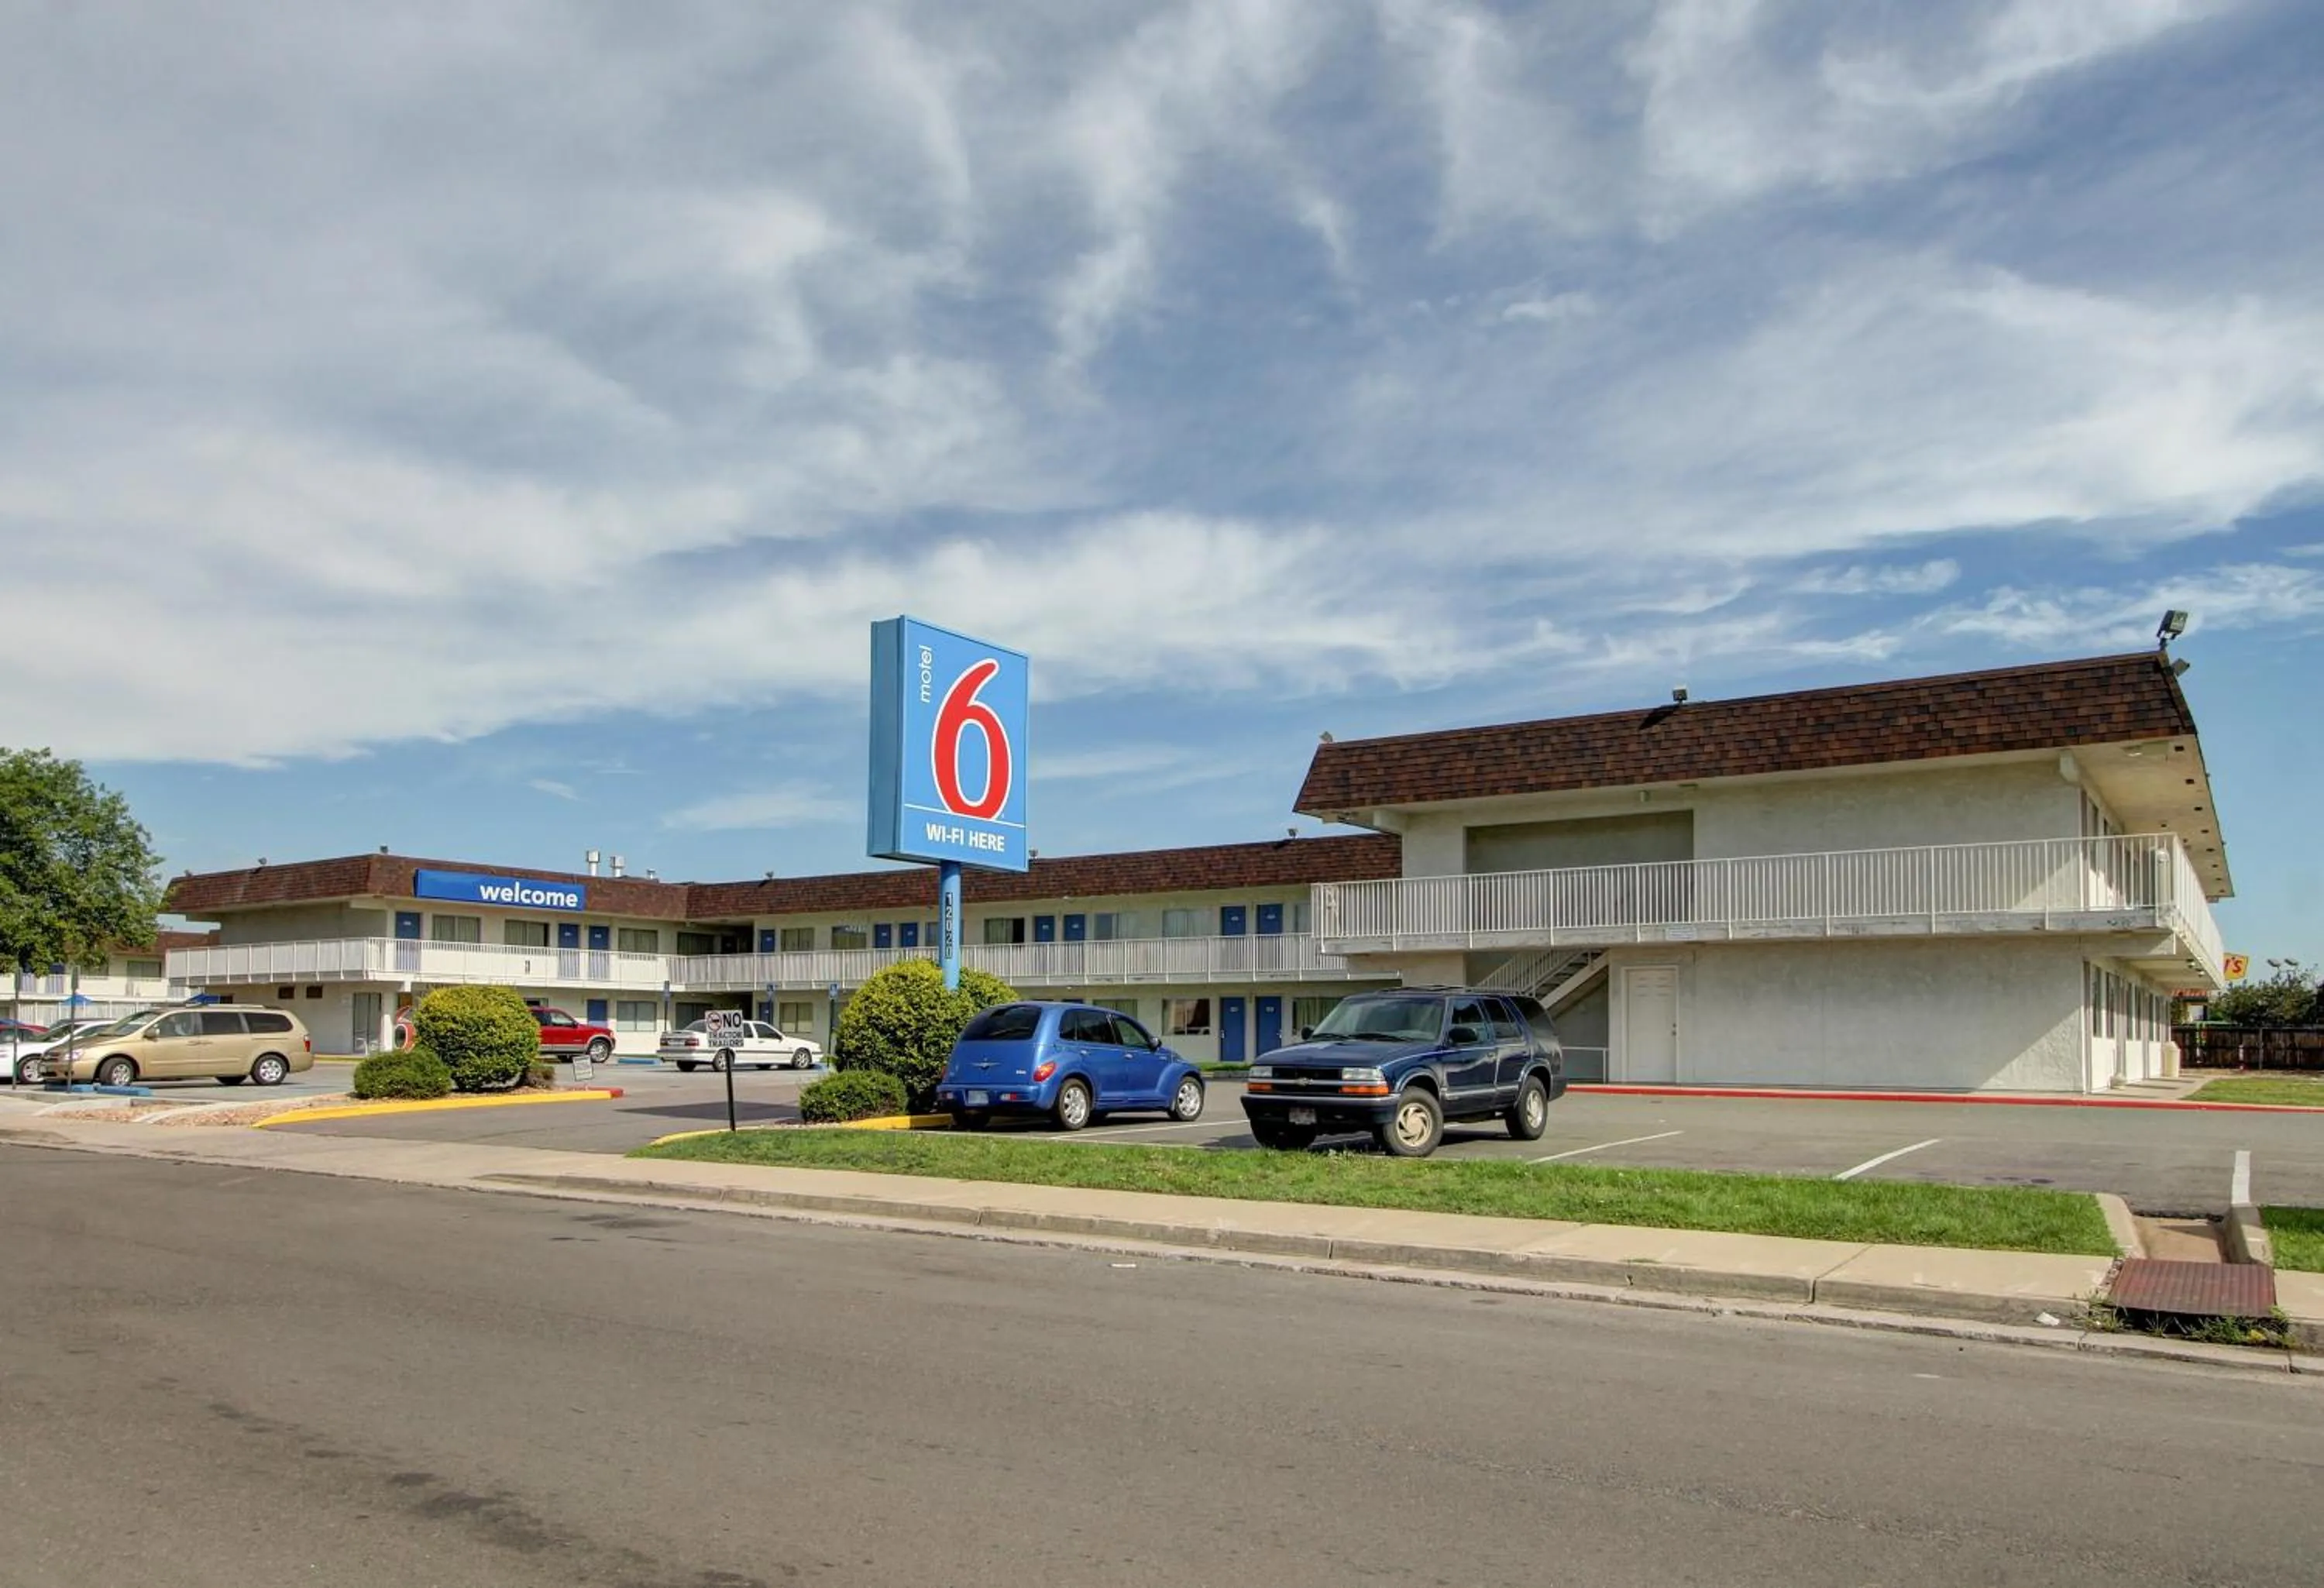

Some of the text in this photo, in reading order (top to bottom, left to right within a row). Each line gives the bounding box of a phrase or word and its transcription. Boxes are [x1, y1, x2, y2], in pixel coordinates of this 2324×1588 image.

[919, 644, 932, 703] motel
[931, 658, 1012, 821] 6
[927, 822, 1005, 852] WI-FI HERE
[480, 881, 578, 907] welcome
[722, 1012, 741, 1028] NO
